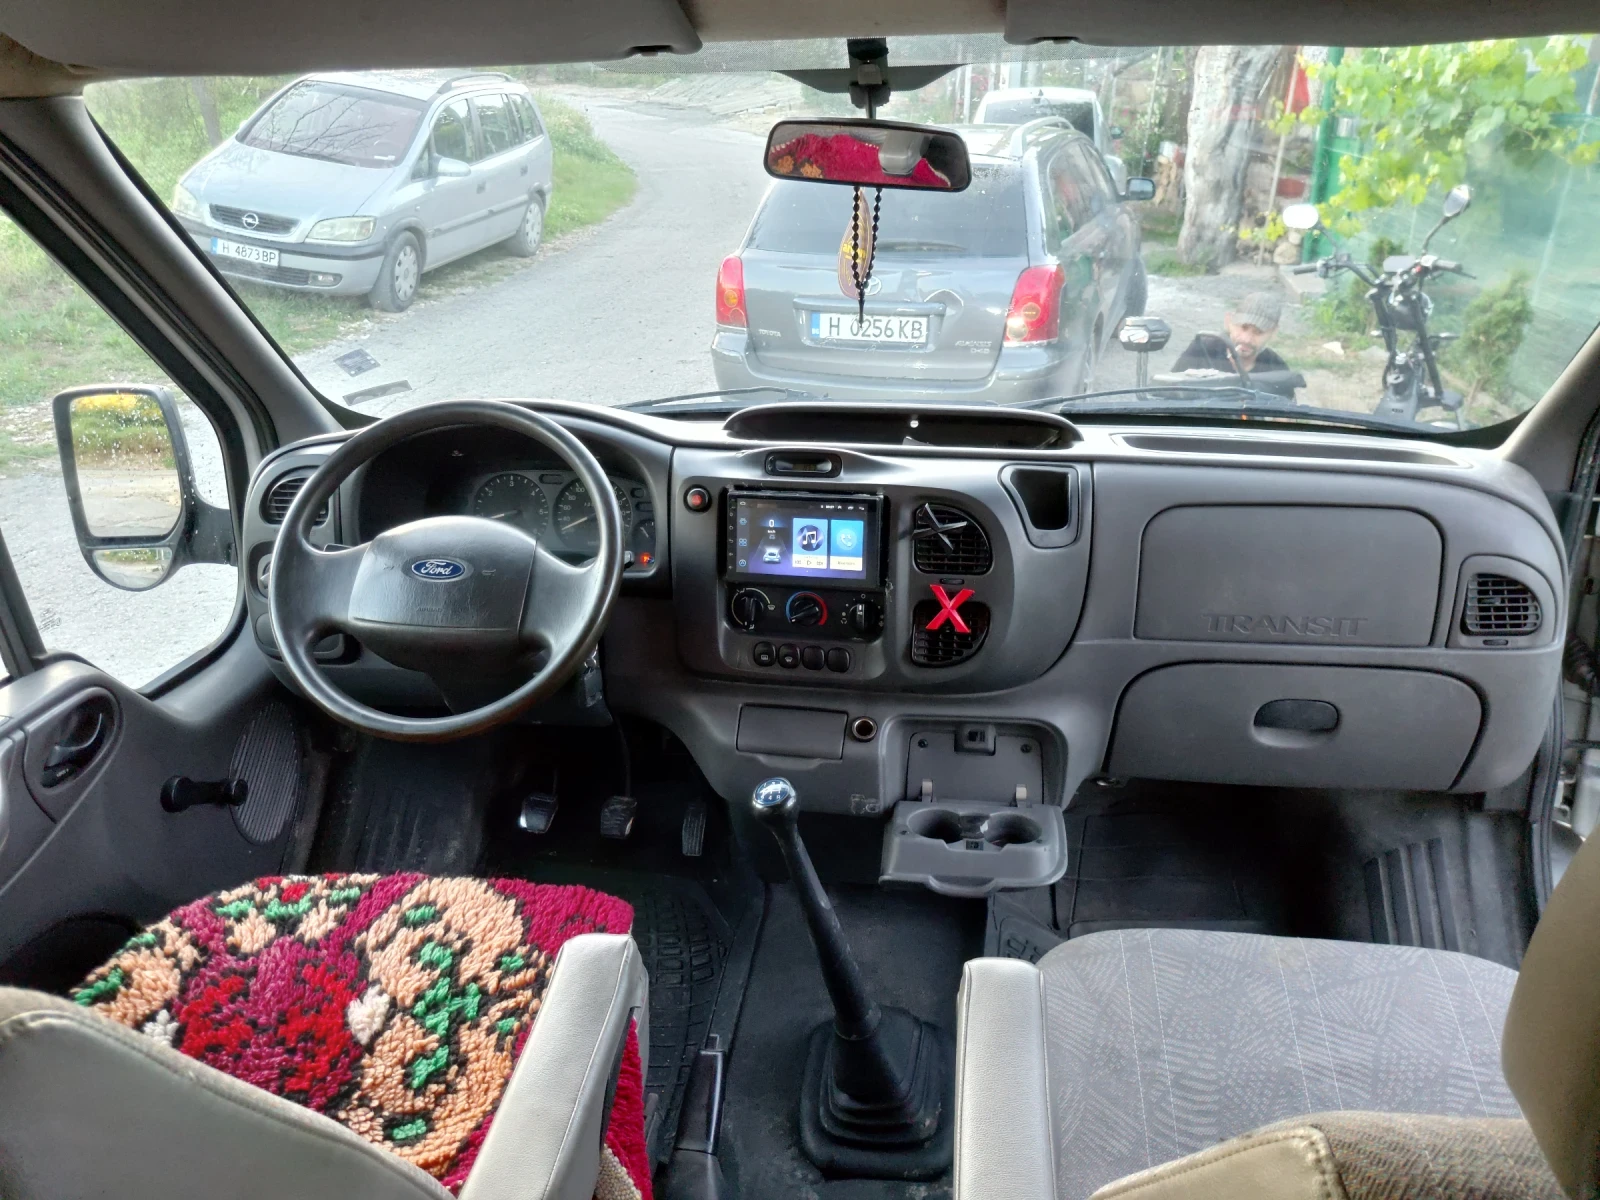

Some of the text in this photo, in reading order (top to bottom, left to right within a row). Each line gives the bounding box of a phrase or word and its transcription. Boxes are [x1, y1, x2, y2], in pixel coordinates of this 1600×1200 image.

[222, 243, 229, 253] H
[829, 316, 841, 337] H
[420, 560, 453, 575] Ford
[1201, 613, 1369, 637] TRANSIT
